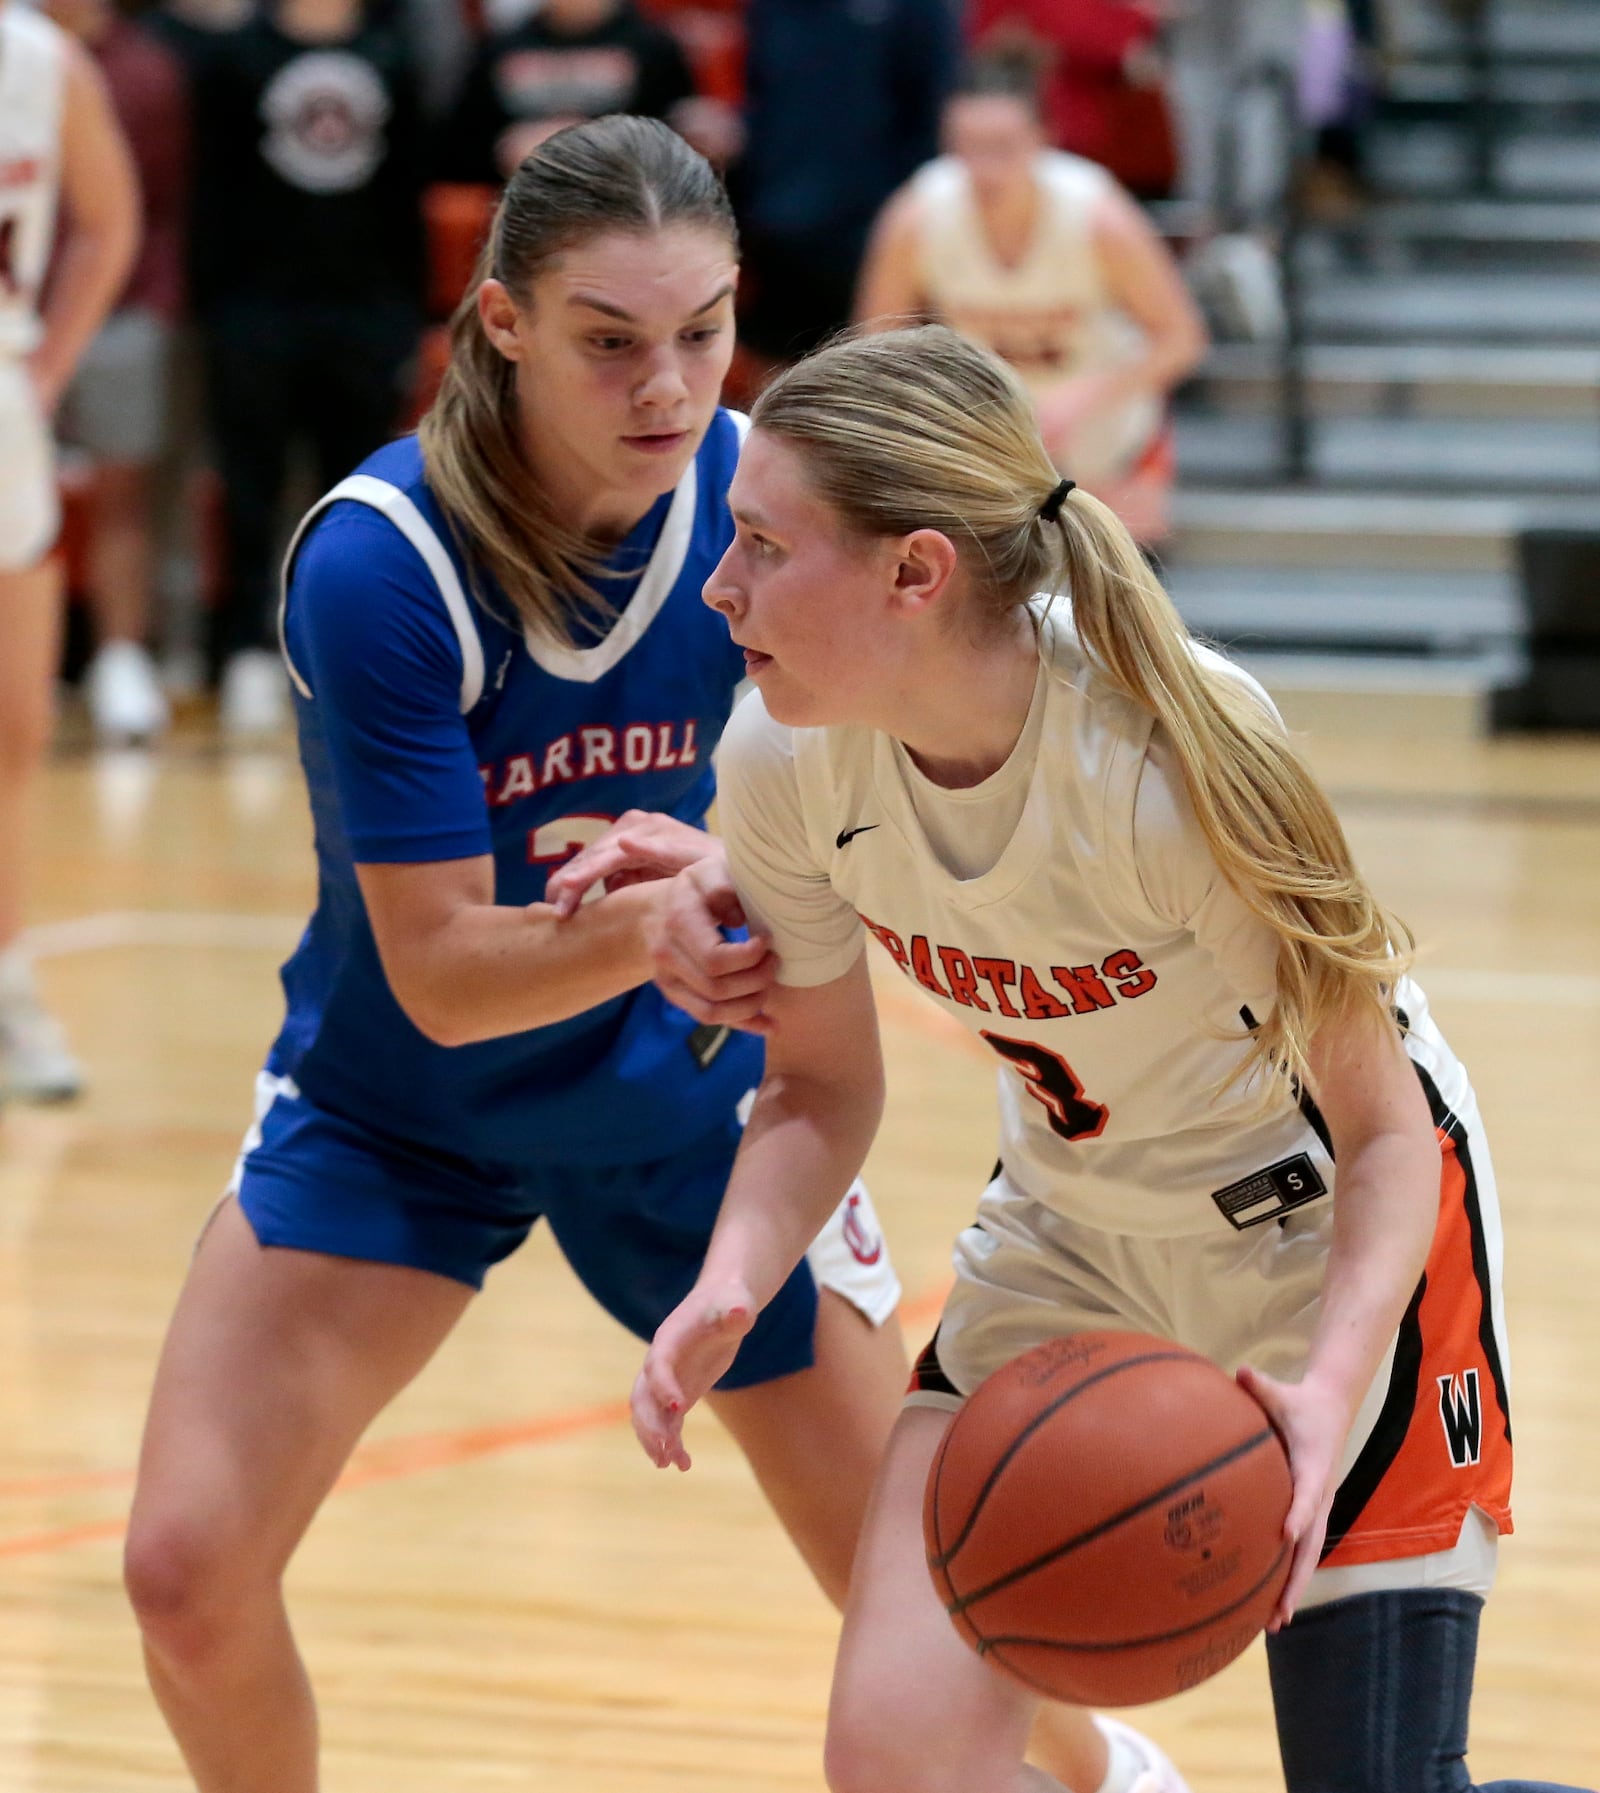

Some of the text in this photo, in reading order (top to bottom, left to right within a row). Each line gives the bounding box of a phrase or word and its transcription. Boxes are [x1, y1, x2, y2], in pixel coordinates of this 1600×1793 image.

[856, 910, 1158, 1019] PARTANS
[1287, 1172, 1304, 1190] S
[1436, 1367, 1482, 1468] W
